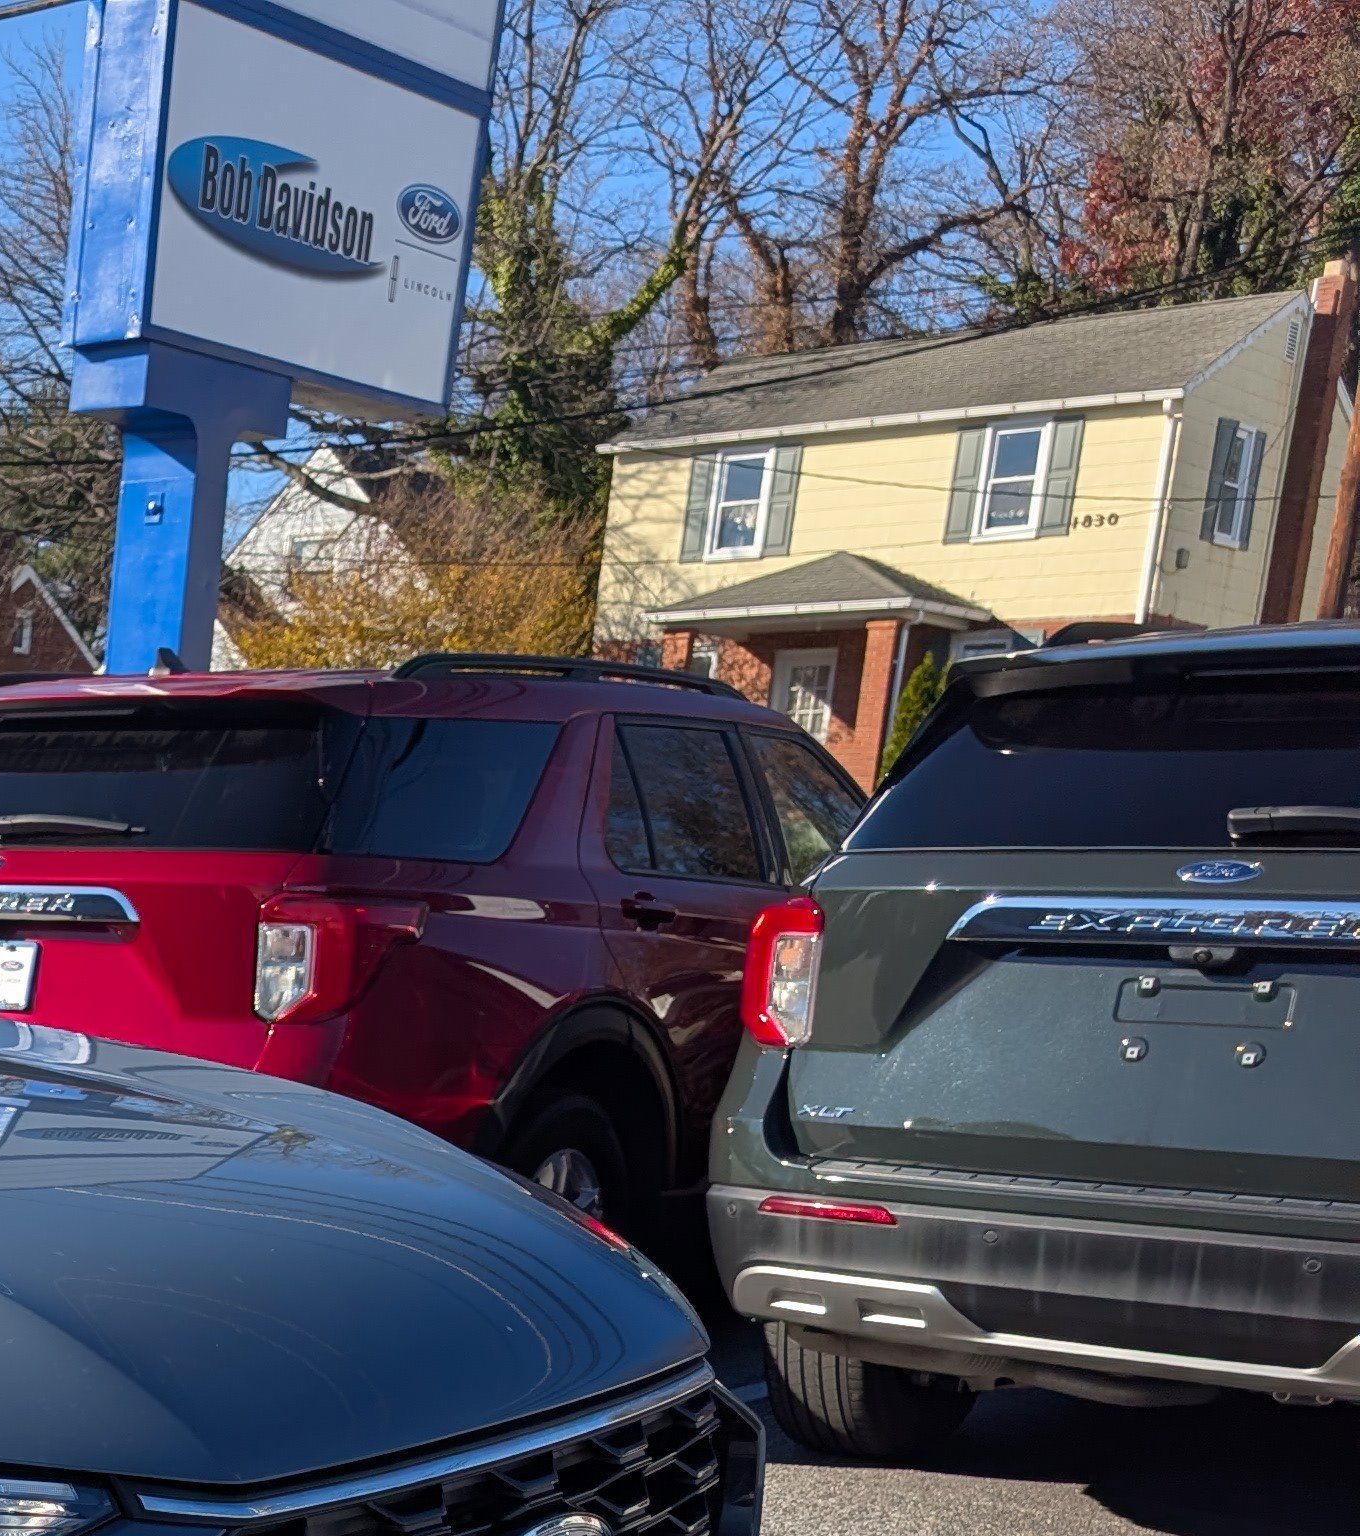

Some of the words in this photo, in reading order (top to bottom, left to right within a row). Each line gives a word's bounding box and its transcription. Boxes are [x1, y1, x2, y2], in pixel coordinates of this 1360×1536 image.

[199, 143, 252, 223] Bob
[256, 163, 374, 263] Davidson
[408, 191, 452, 236] Ford
[403, 277, 452, 301] LINCOLN
[1072, 513, 1120, 530] 1830
[1028, 911, 1360, 939] EXPLORE
[796, 1104, 856, 1119] XLT
